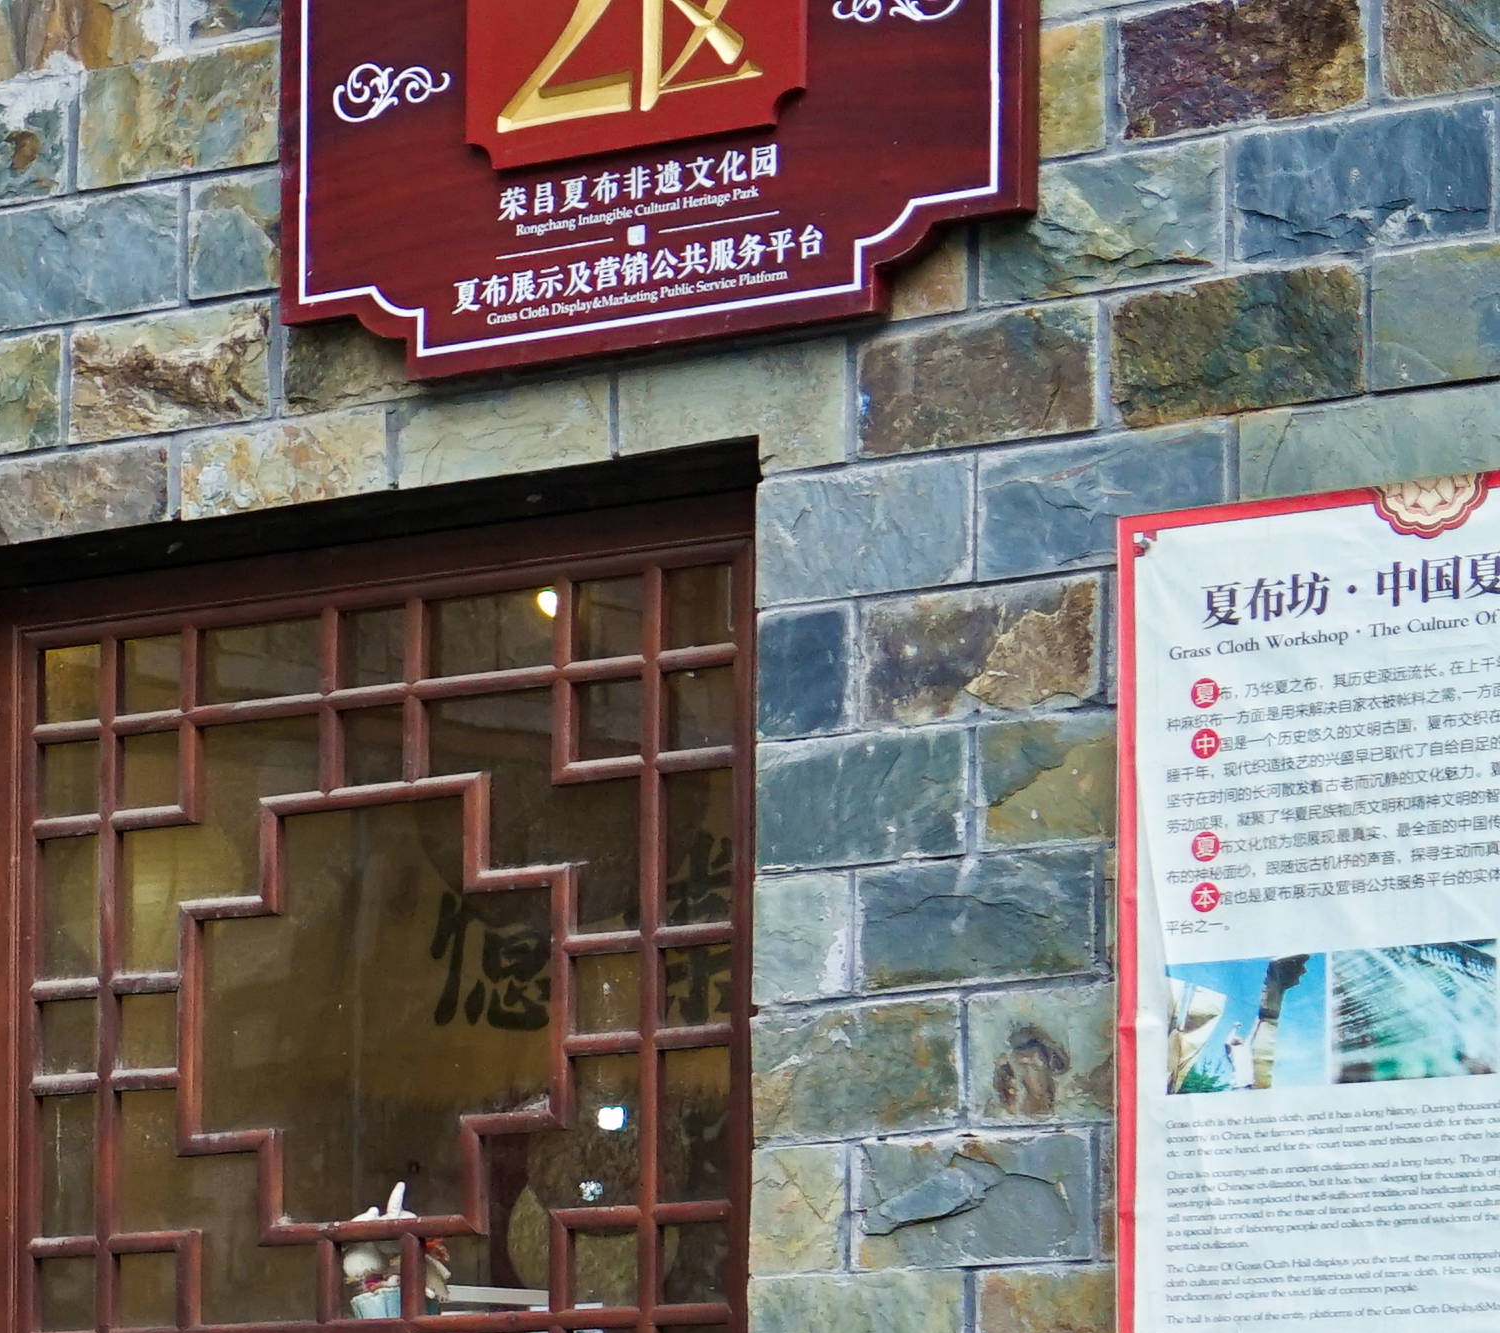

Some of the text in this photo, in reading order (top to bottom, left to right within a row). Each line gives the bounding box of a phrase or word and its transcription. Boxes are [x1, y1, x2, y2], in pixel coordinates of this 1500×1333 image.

[498, 143, 779, 222] 荣昌夏布非遗文化园
[516, 184, 758, 239] Rongchang Intangible Cultural Heritage Park
[453, 225, 825, 313] 夏布展示及营销公共服务平台
[487, 268, 787, 326] Grass Cloth Display&Marketing Public Service Platform
[1169, 610, 1497, 660] Grass Cloth Workshop The Culture Of
[1166, 920, 1231, 935] 平台之一。
[1165, 1118, 1190, 1129] Grass
[1165, 1263, 1184, 1274] The
[1185, 1261, 1218, 1273] Culture
[1220, 1261, 1232, 1271] Of
[1234, 1260, 1262, 1271] Grass
[1263, 1258, 1290, 1269] Cloth
[1291, 1257, 1311, 1268] Hall
[1351, 1257, 1368, 1268] you
[1370, 1254, 1387, 1265] the
[1414, 1252, 1430, 1263] the
